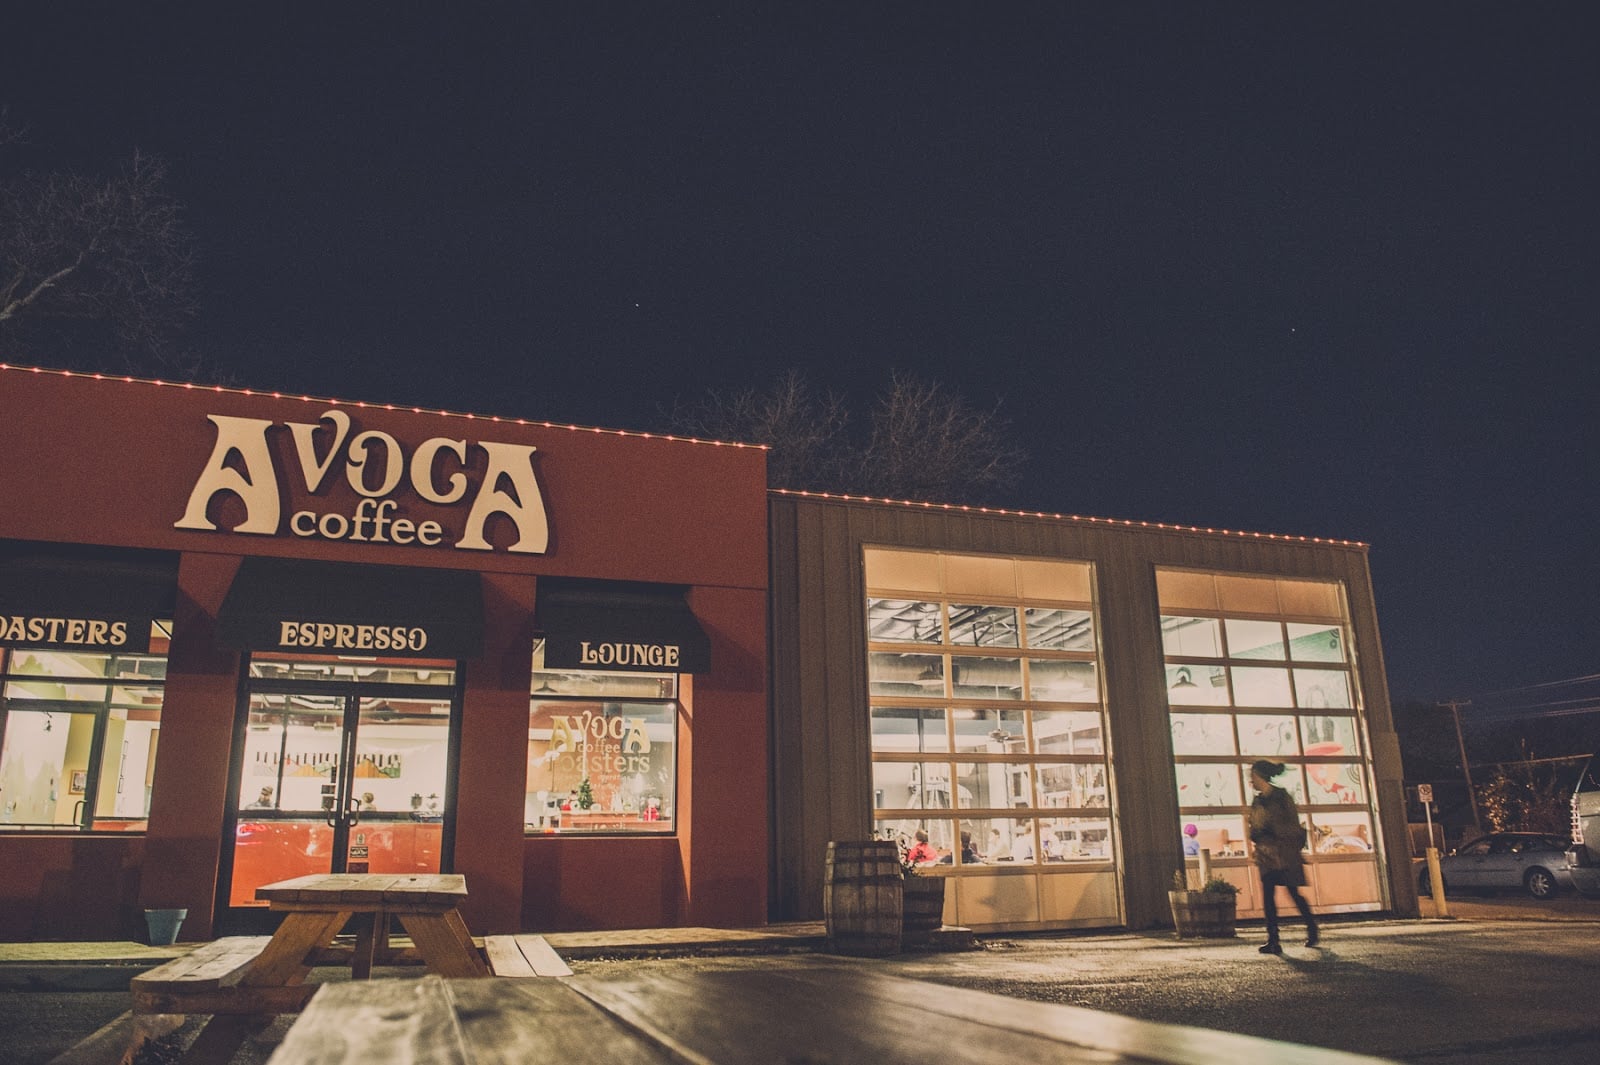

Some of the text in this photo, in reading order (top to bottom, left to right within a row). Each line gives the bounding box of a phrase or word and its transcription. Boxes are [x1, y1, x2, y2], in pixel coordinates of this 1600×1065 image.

[173, 409, 550, 554] AVOCA
[290, 499, 442, 546] coffee
[279, 621, 428, 651] ESPRESSO
[580, 642, 679, 667] LOUNGE
[550, 710, 651, 754] AVOCA
[577, 738, 621, 753] coffee
